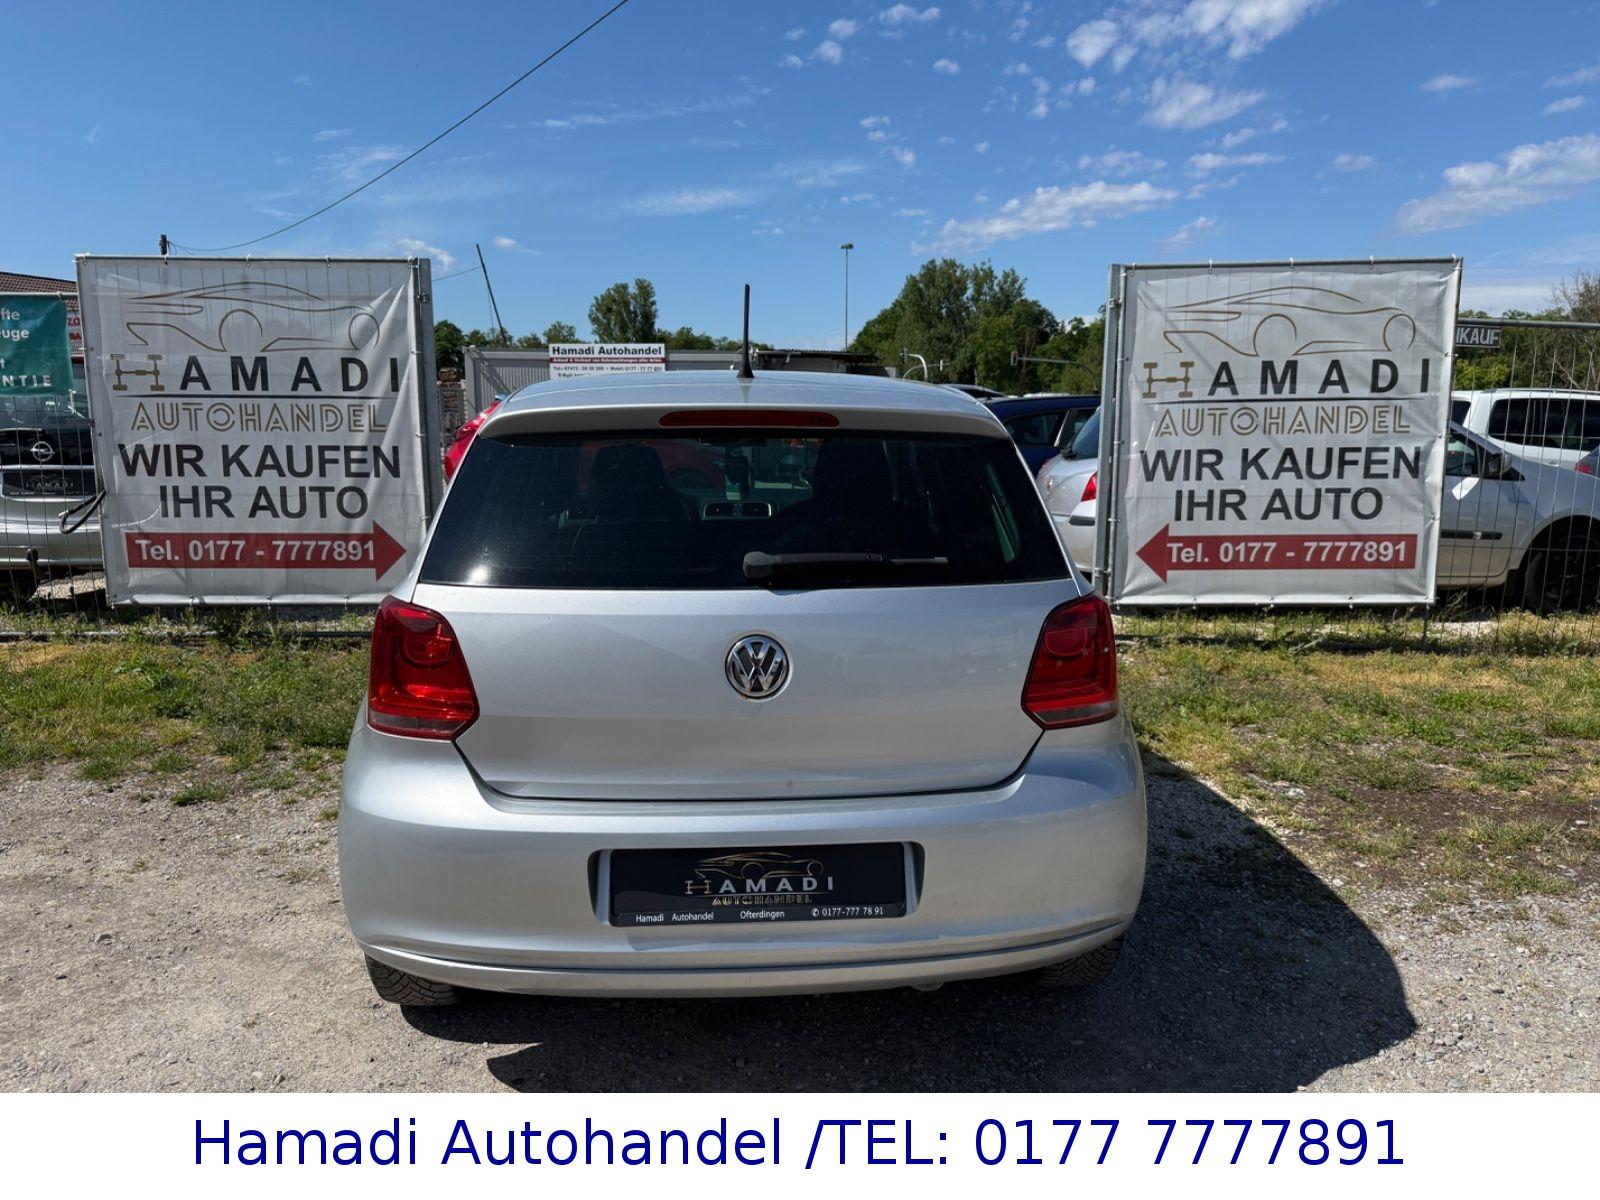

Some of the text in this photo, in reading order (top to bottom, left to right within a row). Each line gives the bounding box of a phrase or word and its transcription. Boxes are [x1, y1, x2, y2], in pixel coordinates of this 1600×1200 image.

[0, 329, 30, 341] uge
[552, 345, 662, 355] Hamadi Autohandel
[111, 354, 399, 392] HAMADI
[1142, 358, 1429, 398] HAMADI
[131, 401, 387, 432] AUTOHANDEL
[1155, 405, 1411, 437] AUTOHANDEL
[118, 443, 401, 479] WIR KAUFEN
[1140, 446, 1421, 482] WIR KAUFEN
[159, 485, 369, 519] IHR AUTO
[1174, 487, 1384, 522] IHR AUTO
[135, 539, 179, 561] Tel.
[188, 540, 246, 561] 0177
[272, 540, 375, 561] 7777891
[1166, 542, 1209, 563] Tel.
[1219, 542, 1277, 563] 0177
[1303, 541, 1406, 562] 7777891
[684, 875, 834, 895] HAMADI
[711, 895, 813, 906] AUTOHANDEL
[635, 907, 883, 923] Hamadi Autohandel Ofterdingen 0177-777 78 91
